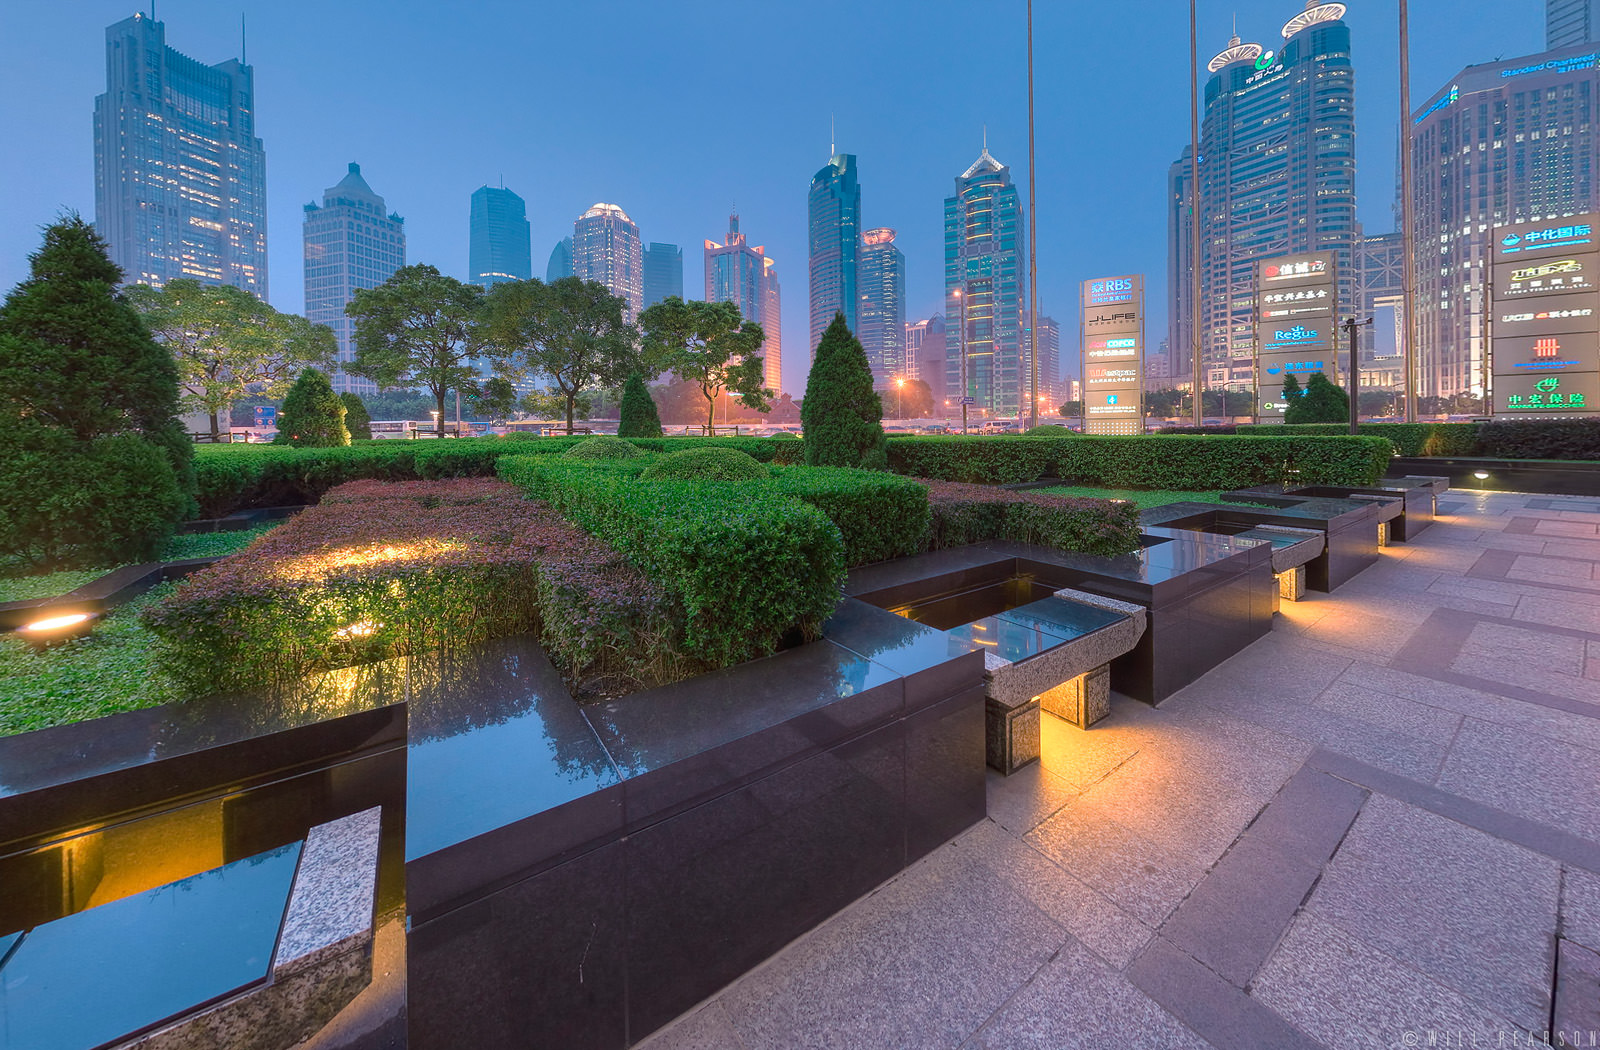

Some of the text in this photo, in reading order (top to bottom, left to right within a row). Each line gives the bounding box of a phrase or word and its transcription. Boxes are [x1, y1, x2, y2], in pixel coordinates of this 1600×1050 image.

[1501, 53, 1596, 77] Standard Chartered
[1525, 225, 1591, 242] 中化国际
[1105, 278, 1132, 291] RBS
[1274, 328, 1318, 340] Regus
[1508, 393, 1584, 405] 中宏保险
